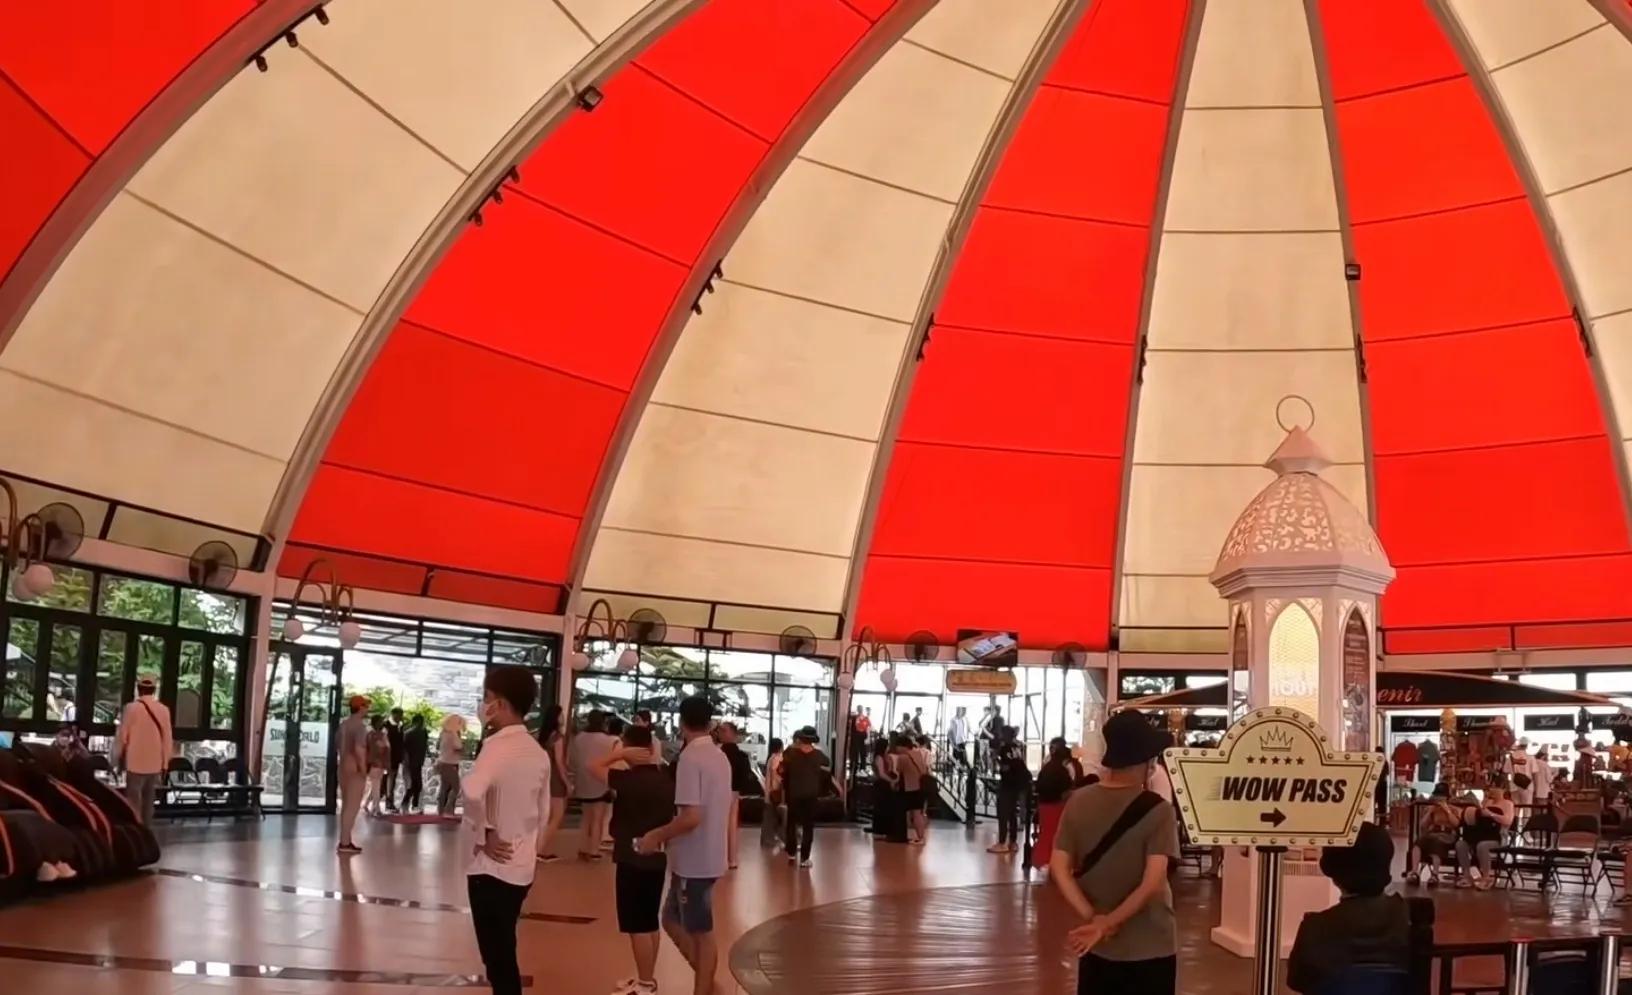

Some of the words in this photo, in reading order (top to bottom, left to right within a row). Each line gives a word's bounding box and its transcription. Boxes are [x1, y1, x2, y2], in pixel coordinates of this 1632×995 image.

[1377, 685, 1425, 702] enir
[1222, 776, 1287, 802] WOW
[1288, 778, 1347, 803] PASS
